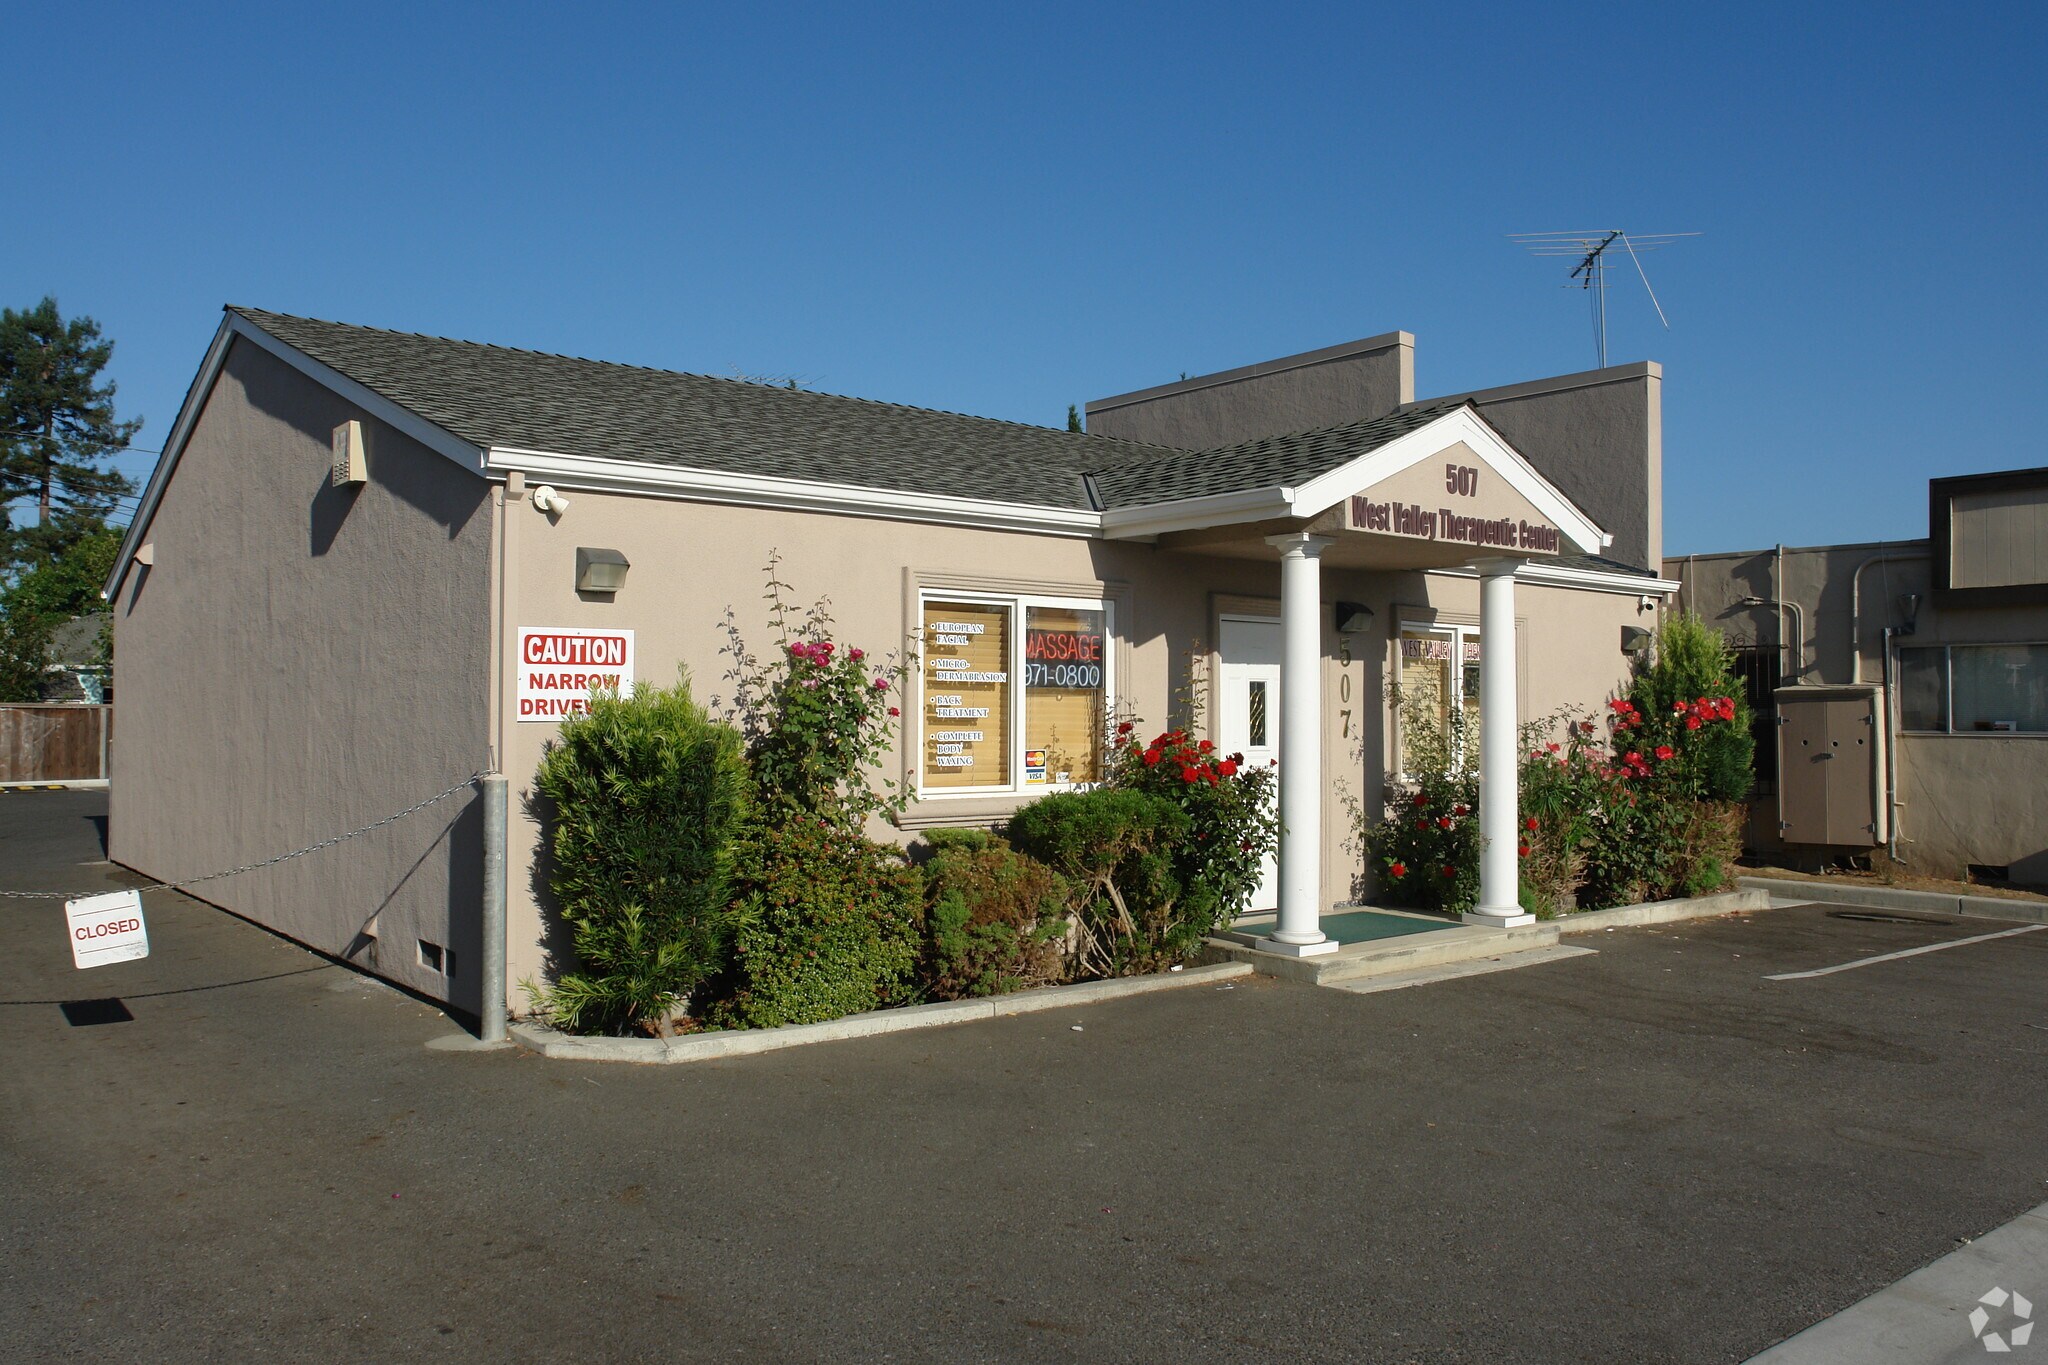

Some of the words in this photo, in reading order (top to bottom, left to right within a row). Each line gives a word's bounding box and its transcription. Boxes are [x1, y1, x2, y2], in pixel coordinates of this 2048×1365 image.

[1446, 463, 1478, 498] 507
[1352, 495, 1390, 532] West
[1392, 502, 1437, 541] Valley
[1439, 508, 1517, 547] Therapeutic
[1519, 519, 1559, 552] Center
[937, 623, 983, 633] EUROPEAN
[937, 635, 968, 645] FACIAL
[527, 636, 622, 664] CAUTION
[1402, 640, 1421, 657] WEST
[1424, 641, 1453, 659] VALLEY
[1463, 643, 1480, 660] THE
[937, 659, 970, 669] MICRO-
[529, 673, 621, 690] NARROW
[937, 671, 1006, 682] DERMABRASION
[1340, 636, 1351, 739] 507
[937, 696, 961, 705] BACK
[937, 708, 988, 718] TREATMENT
[937, 732, 982, 741] COMPLETE
[938, 745, 962, 754] BODY
[937, 757, 973, 766] WAXING
[75, 918, 140, 941] CLOSED
